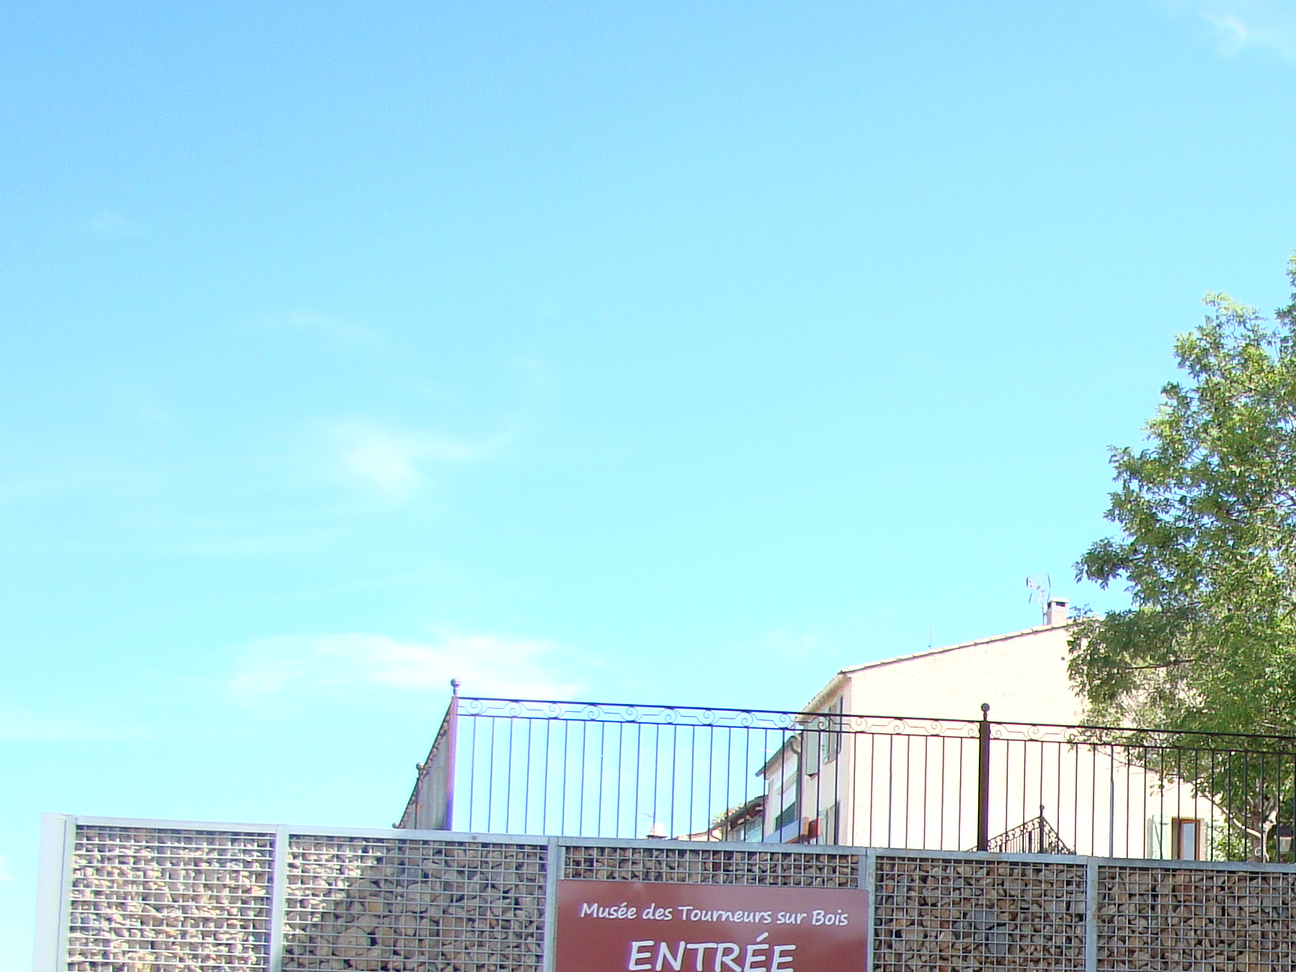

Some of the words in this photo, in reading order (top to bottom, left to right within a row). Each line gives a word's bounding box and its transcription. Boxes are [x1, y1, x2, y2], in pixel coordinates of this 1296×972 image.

[580, 901, 637, 919] Musée
[642, 903, 673, 921] des
[677, 906, 773, 925] Tourneurs
[776, 910, 808, 926] sur
[811, 909, 849, 927] Bois
